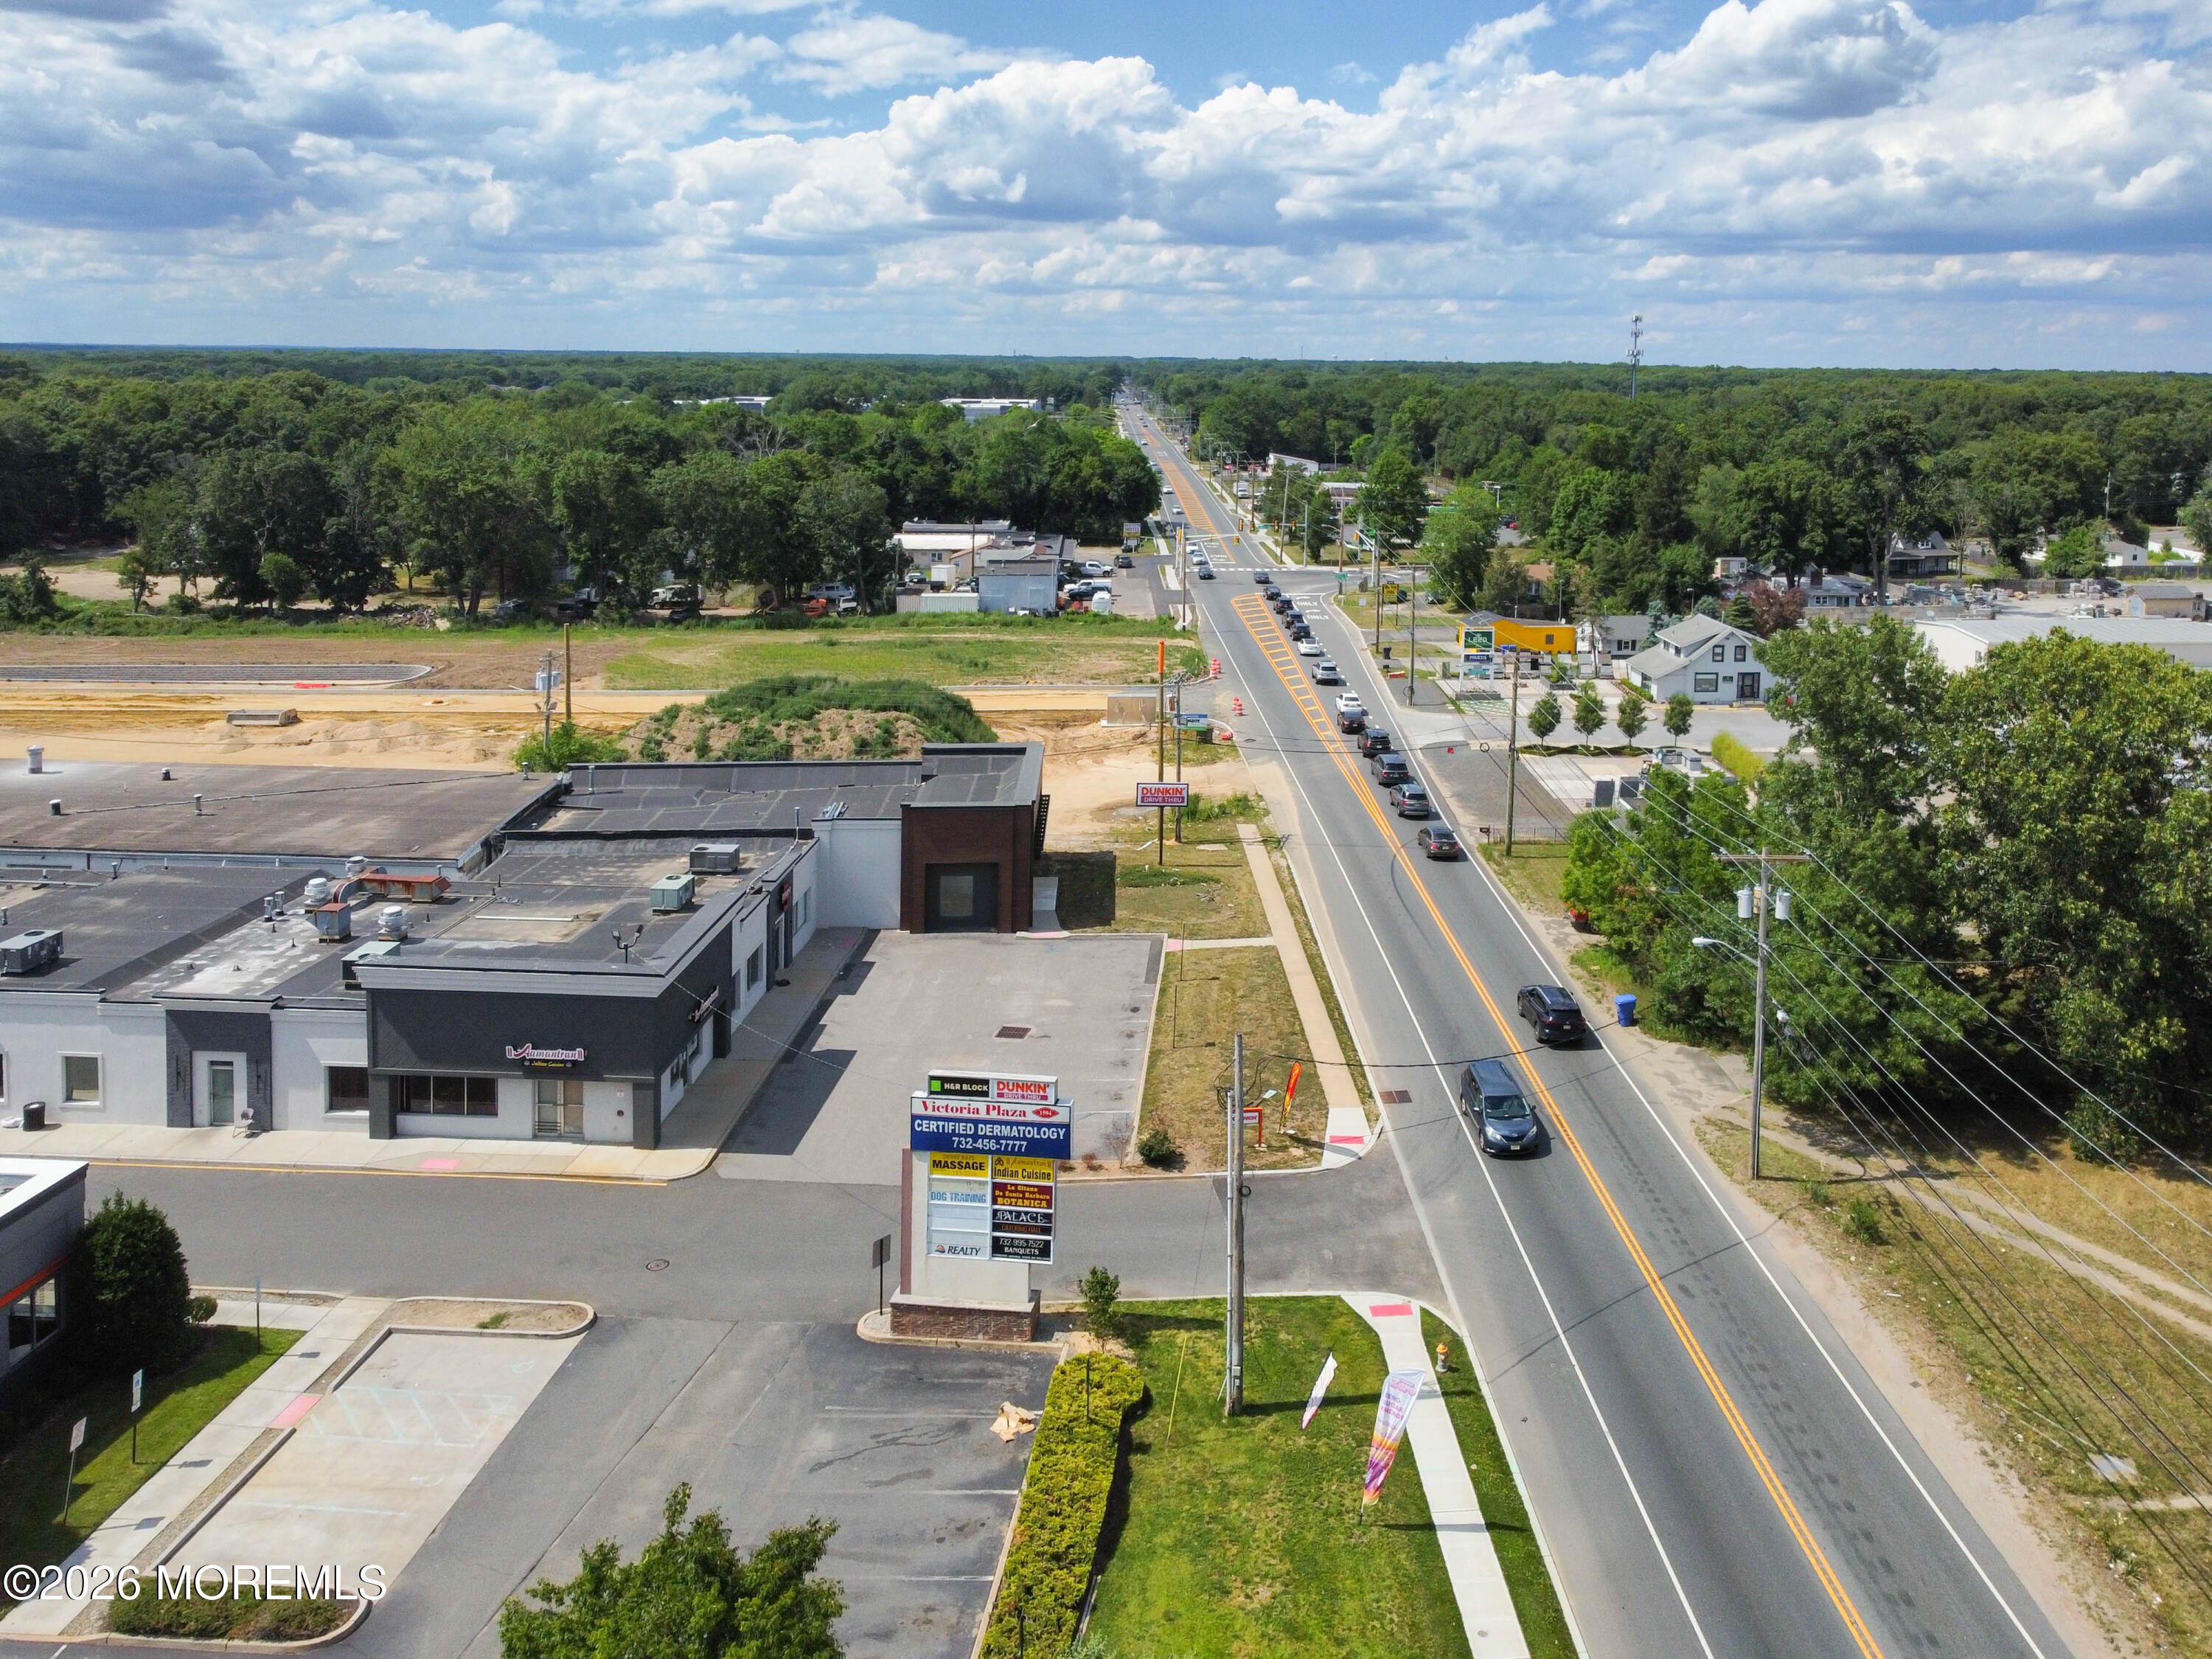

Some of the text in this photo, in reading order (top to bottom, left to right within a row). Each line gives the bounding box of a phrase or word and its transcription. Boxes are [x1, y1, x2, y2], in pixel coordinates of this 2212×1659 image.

[1141, 787, 1186, 796] DUNKIN'
[997, 1081, 1049, 1093] DUNKIN'
[922, 1100, 1027, 1117] Victoria Plaza
[914, 1119, 1066, 1139] CERTIFIED DERMATOLOGY
[952, 1137, 1027, 1152] 732-456-7777
[933, 1159, 985, 1171] MASSAGE
[994, 1166, 1051, 1180] Indian Cuisine
[931, 1192, 987, 1203] DOG TRAINING
[997, 1197, 1048, 1207] BOTANICA
[996, 1211, 1048, 1223] PALACE
[947, 1246, 981, 1256] REALTY
[1004, 1247, 1039, 1255] BANQUETS
